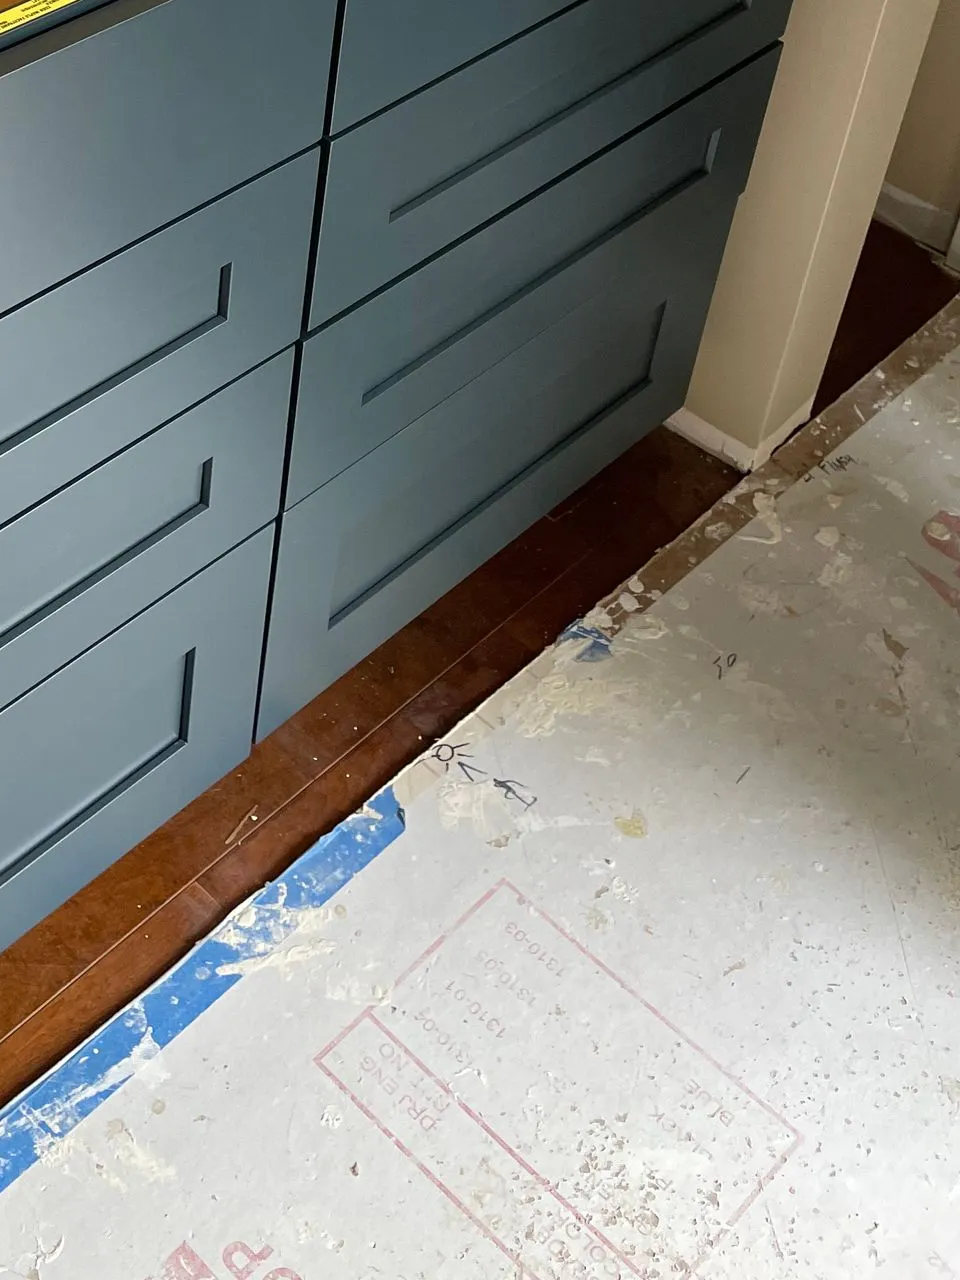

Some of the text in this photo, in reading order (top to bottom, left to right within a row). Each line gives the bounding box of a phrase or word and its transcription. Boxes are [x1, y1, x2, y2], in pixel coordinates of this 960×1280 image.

[503, 920, 566, 977] 1310-03
[443, 979, 508, 1039] 1310-01
[376, 1041, 408, 1072] NO
[357, 1055, 436, 1132] DRJ ENG
[684, 1079, 735, 1126] BLUE
